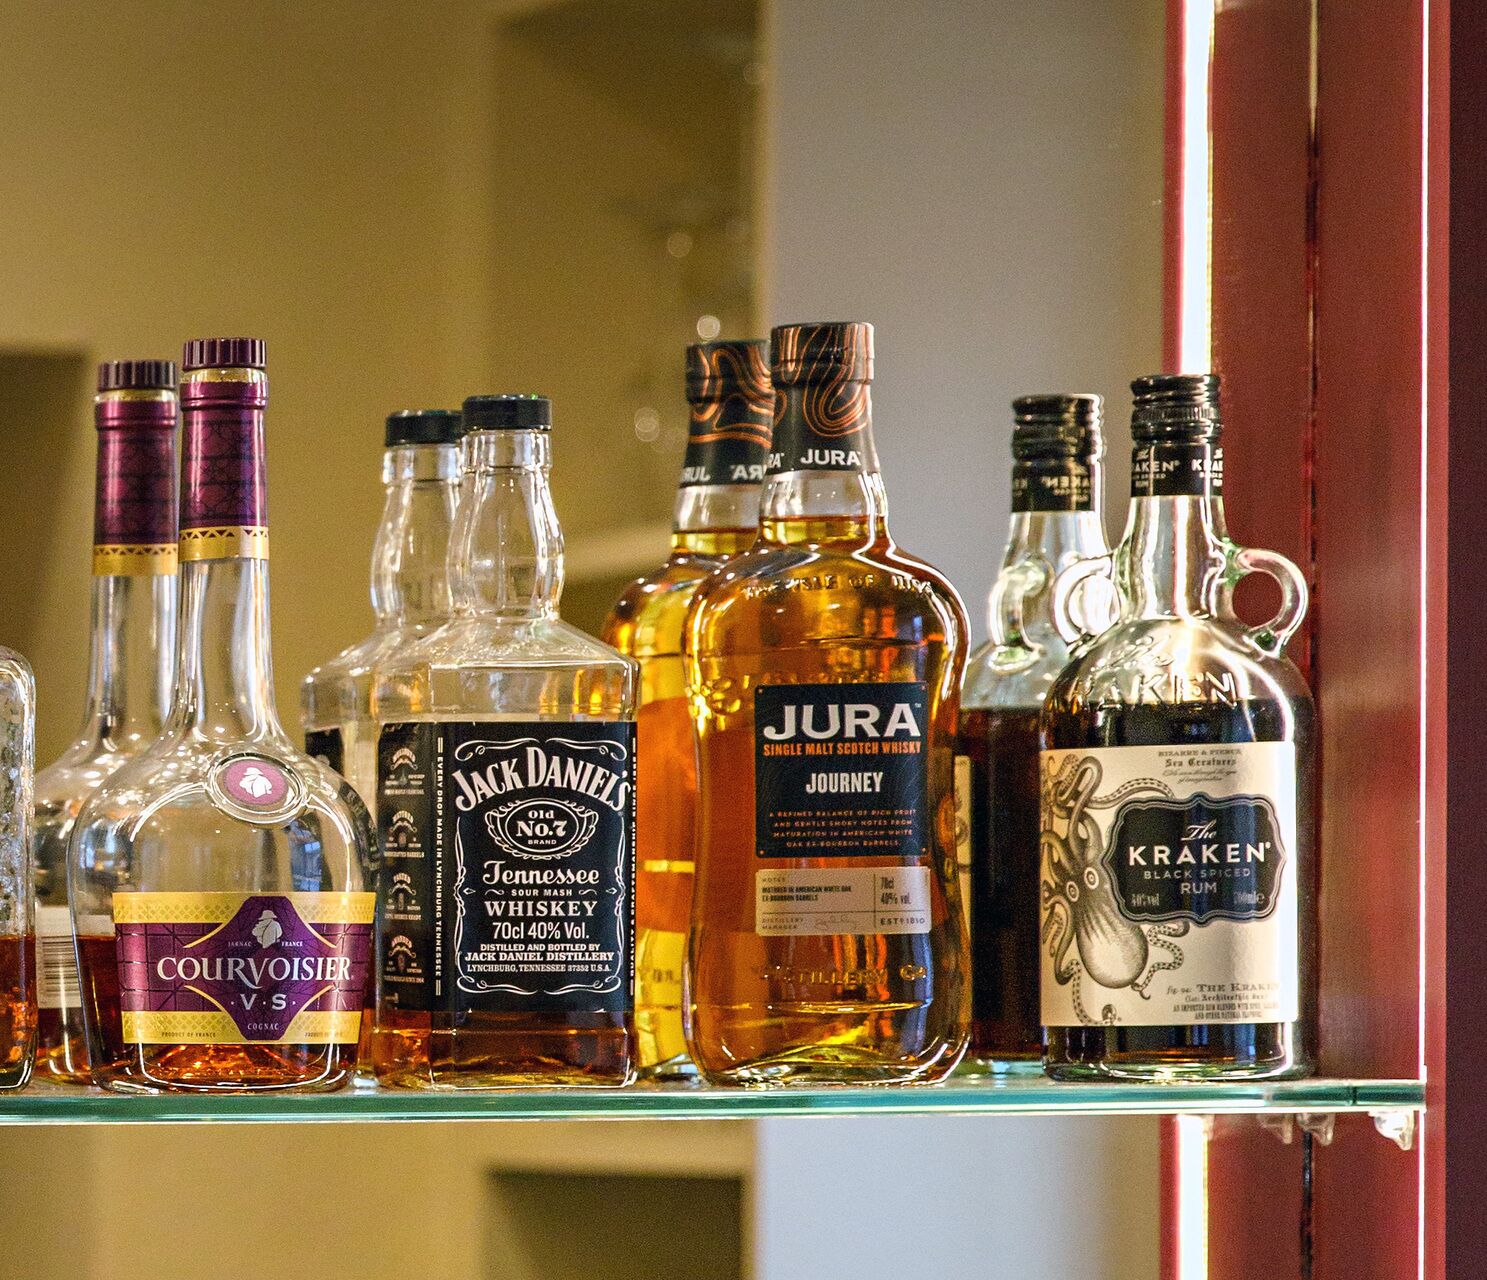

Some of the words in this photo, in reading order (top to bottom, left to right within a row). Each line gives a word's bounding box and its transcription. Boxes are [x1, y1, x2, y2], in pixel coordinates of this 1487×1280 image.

[763, 702, 922, 742] JURA
[763, 743, 802, 758] SINGLE
[805, 742, 834, 756] MALT
[836, 742, 879, 756] SCOTCH
[880, 742, 922, 756] WHISKY
[452, 758, 524, 812] JACK
[526, 746, 631, 817] DANIEL'S
[806, 771, 884, 794] JOURNEY
[528, 810, 554, 820] Old
[1128, 844, 1265, 866] KRAKEN
[482, 860, 600, 886] Tennessee
[1144, 870, 1192, 880] BLACK
[1200, 870, 1251, 879] SPICED
[510, 888, 539, 898] SOUR
[544, 888, 573, 898] MASH
[1180, 882, 1218, 896] RUM
[484, 900, 599, 918] WHISKEY
[492, 922, 524, 940] 70cl
[528, 922, 562, 940] 40%
[564, 922, 590, 940] Vol.
[480, 944, 525, 952] DISTILLED
[526, 944, 544, 952] AND
[548, 944, 588, 952] BOTTLED
[588, 944, 601, 952] BY
[464, 952, 498, 963] JACK
[500, 952, 544, 963] DANIEL
[546, 952, 614, 963] DISTILLERY
[156, 956, 352, 989] COURVOISIER
[248, 1022, 280, 1032] COGNAC
